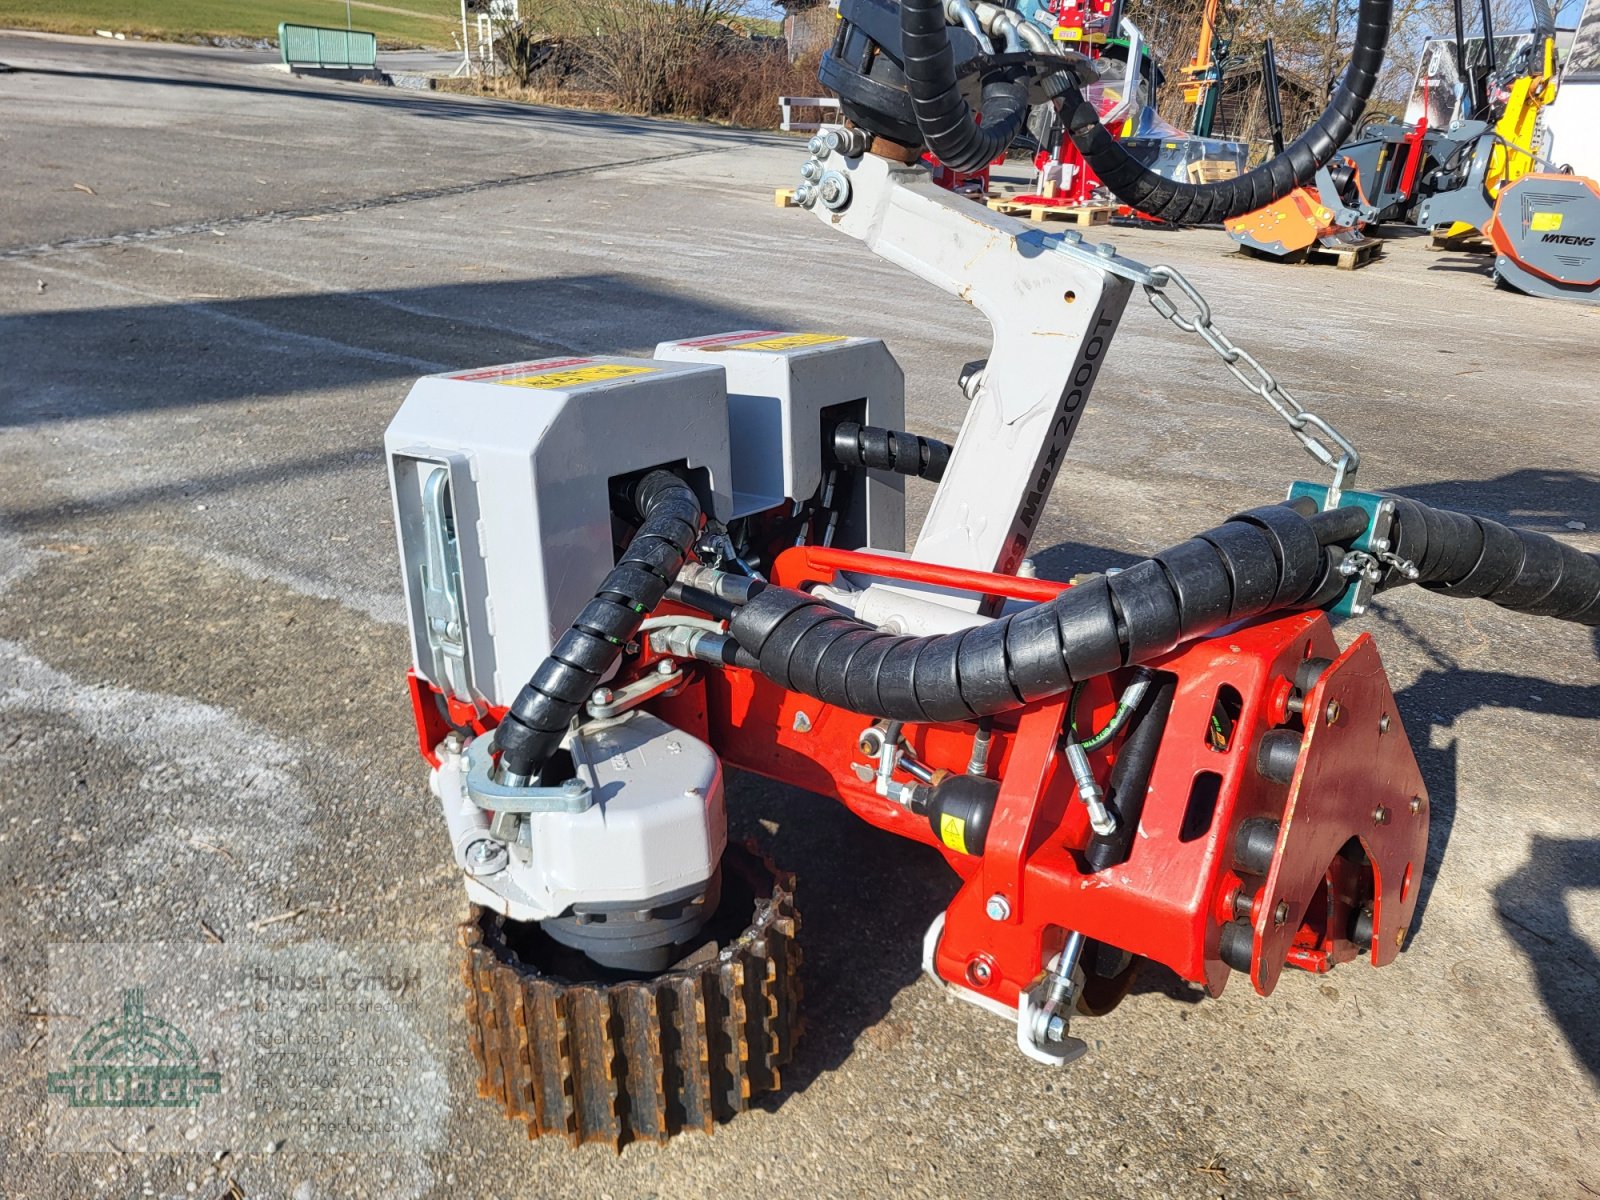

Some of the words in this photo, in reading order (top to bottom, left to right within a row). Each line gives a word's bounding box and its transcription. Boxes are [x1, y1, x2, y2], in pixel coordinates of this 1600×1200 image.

[1541, 233, 1596, 247] MATENG
[1019, 444, 1062, 529] Max
[1053, 308, 1113, 438] 2000T
